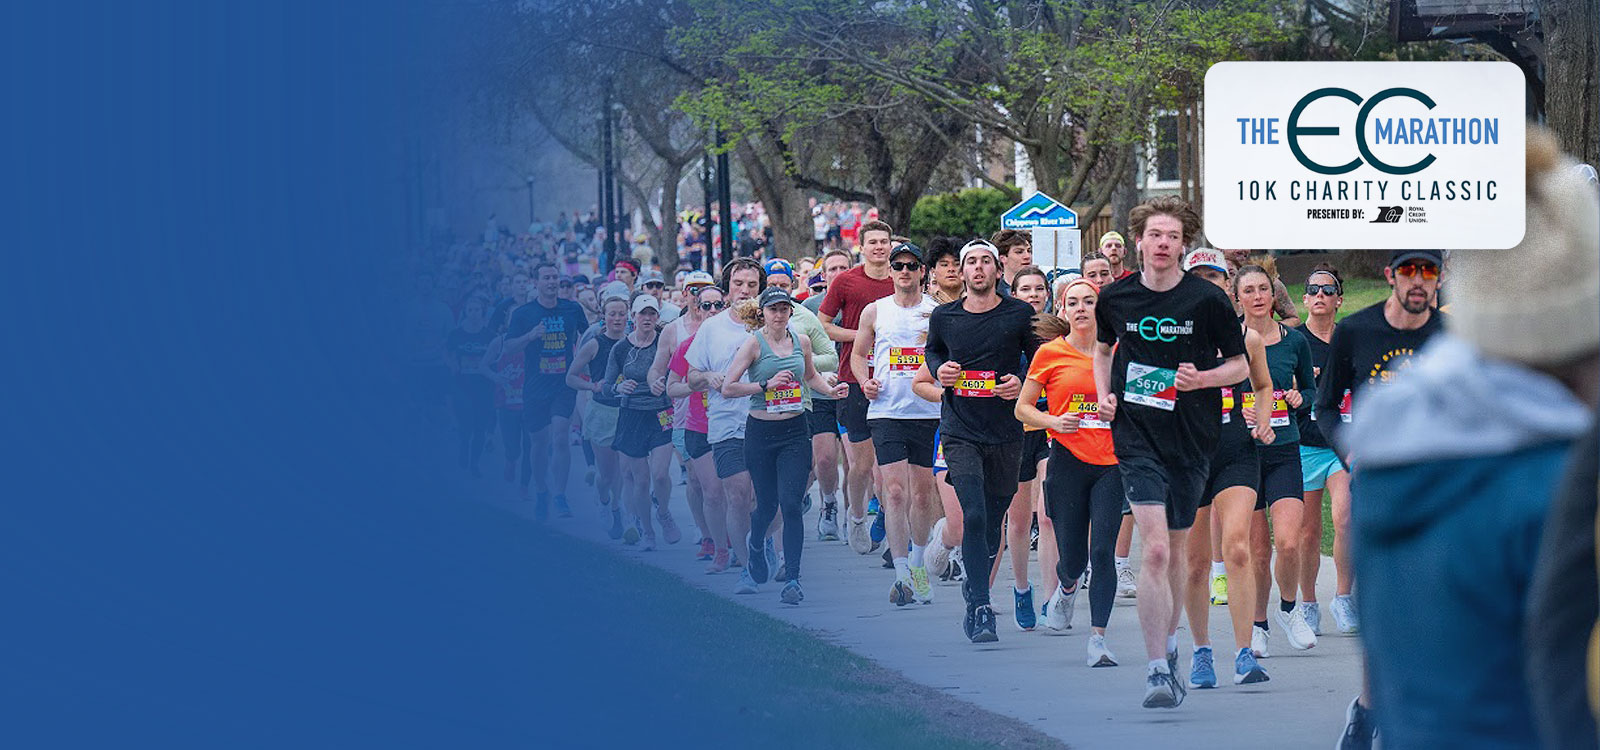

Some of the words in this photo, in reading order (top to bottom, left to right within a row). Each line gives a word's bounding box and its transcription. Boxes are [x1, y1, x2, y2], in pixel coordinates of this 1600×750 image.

[1040, 217, 1058, 225] River
[1059, 216, 1074, 225] Trail
[1126, 322, 1138, 332] THE
[1139, 316, 1178, 342] EC
[1160, 325, 1194, 335] MARATHON
[962, 380, 986, 389] 4602
[1136, 378, 1166, 392] 5670
[1078, 402, 1098, 412] 446
